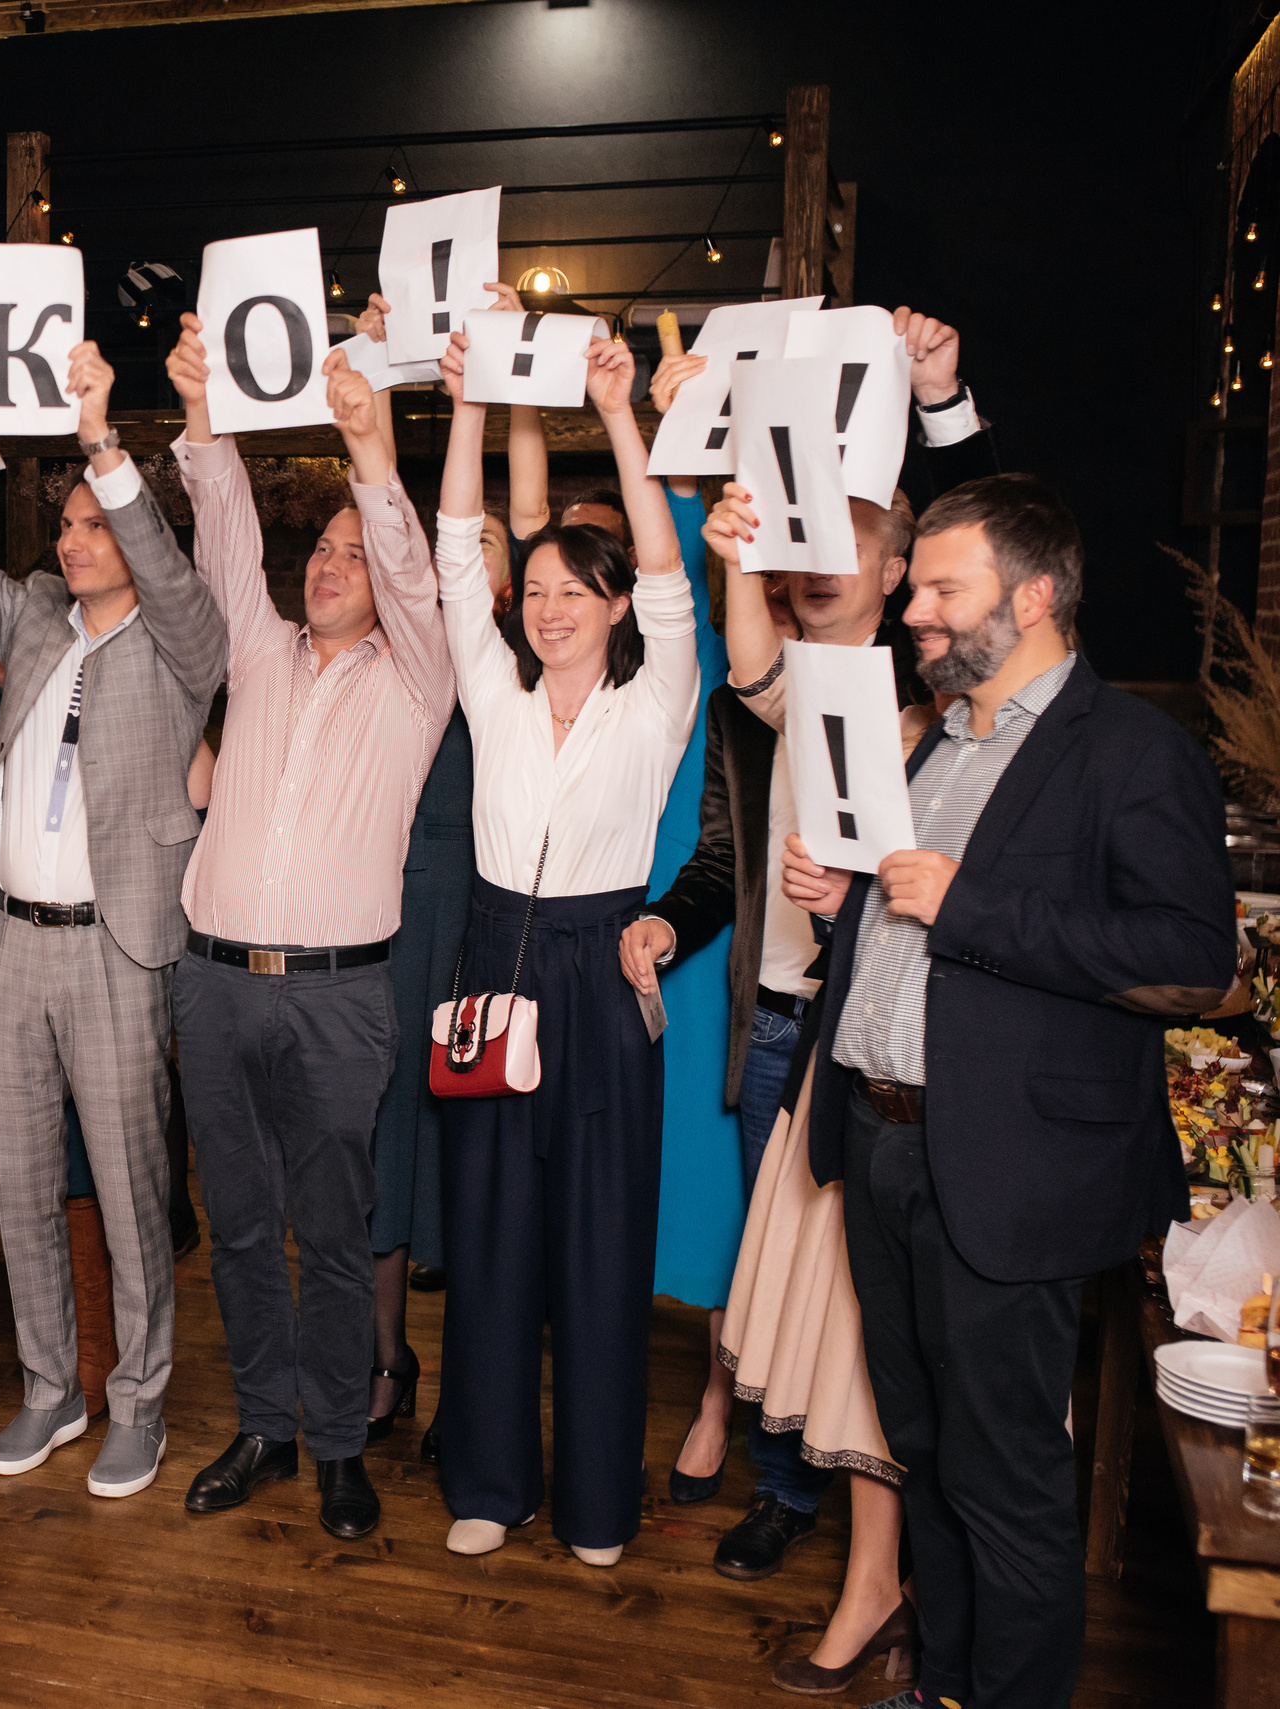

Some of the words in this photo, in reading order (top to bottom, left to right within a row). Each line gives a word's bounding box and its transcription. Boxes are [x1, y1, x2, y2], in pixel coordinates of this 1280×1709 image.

[431, 238, 454, 335] !
[224, 295, 313, 402] О
[835, 362, 869, 466] !
[769, 426, 807, 544] !
[821, 713, 859, 841] !
